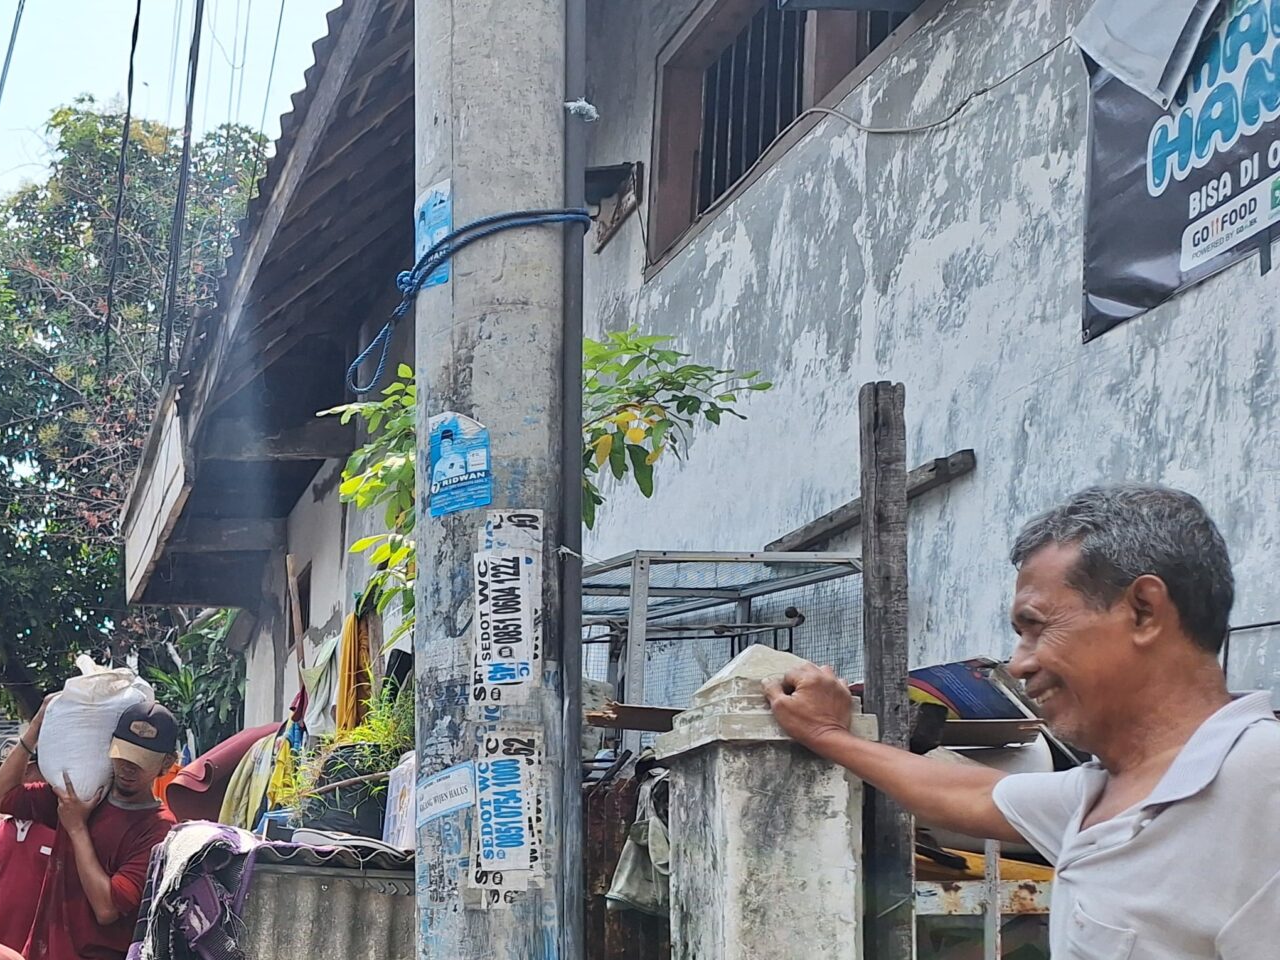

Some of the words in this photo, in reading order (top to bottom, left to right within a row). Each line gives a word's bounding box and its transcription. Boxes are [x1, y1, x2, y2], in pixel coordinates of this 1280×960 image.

[1188, 171, 1232, 220] BISA
[1240, 151, 1260, 189] DI
[442, 470, 486, 488] RIDWAN
[477, 559, 489, 605] WC
[491, 586, 522, 614] 0604
[478, 611, 491, 661] SEDOT
[493, 618, 522, 644] 0851
[477, 762, 491, 794] WC
[490, 758, 521, 788] 1000
[493, 789, 523, 819] 0754
[480, 798, 494, 860] SEDOT
[494, 821, 524, 848] 0851
